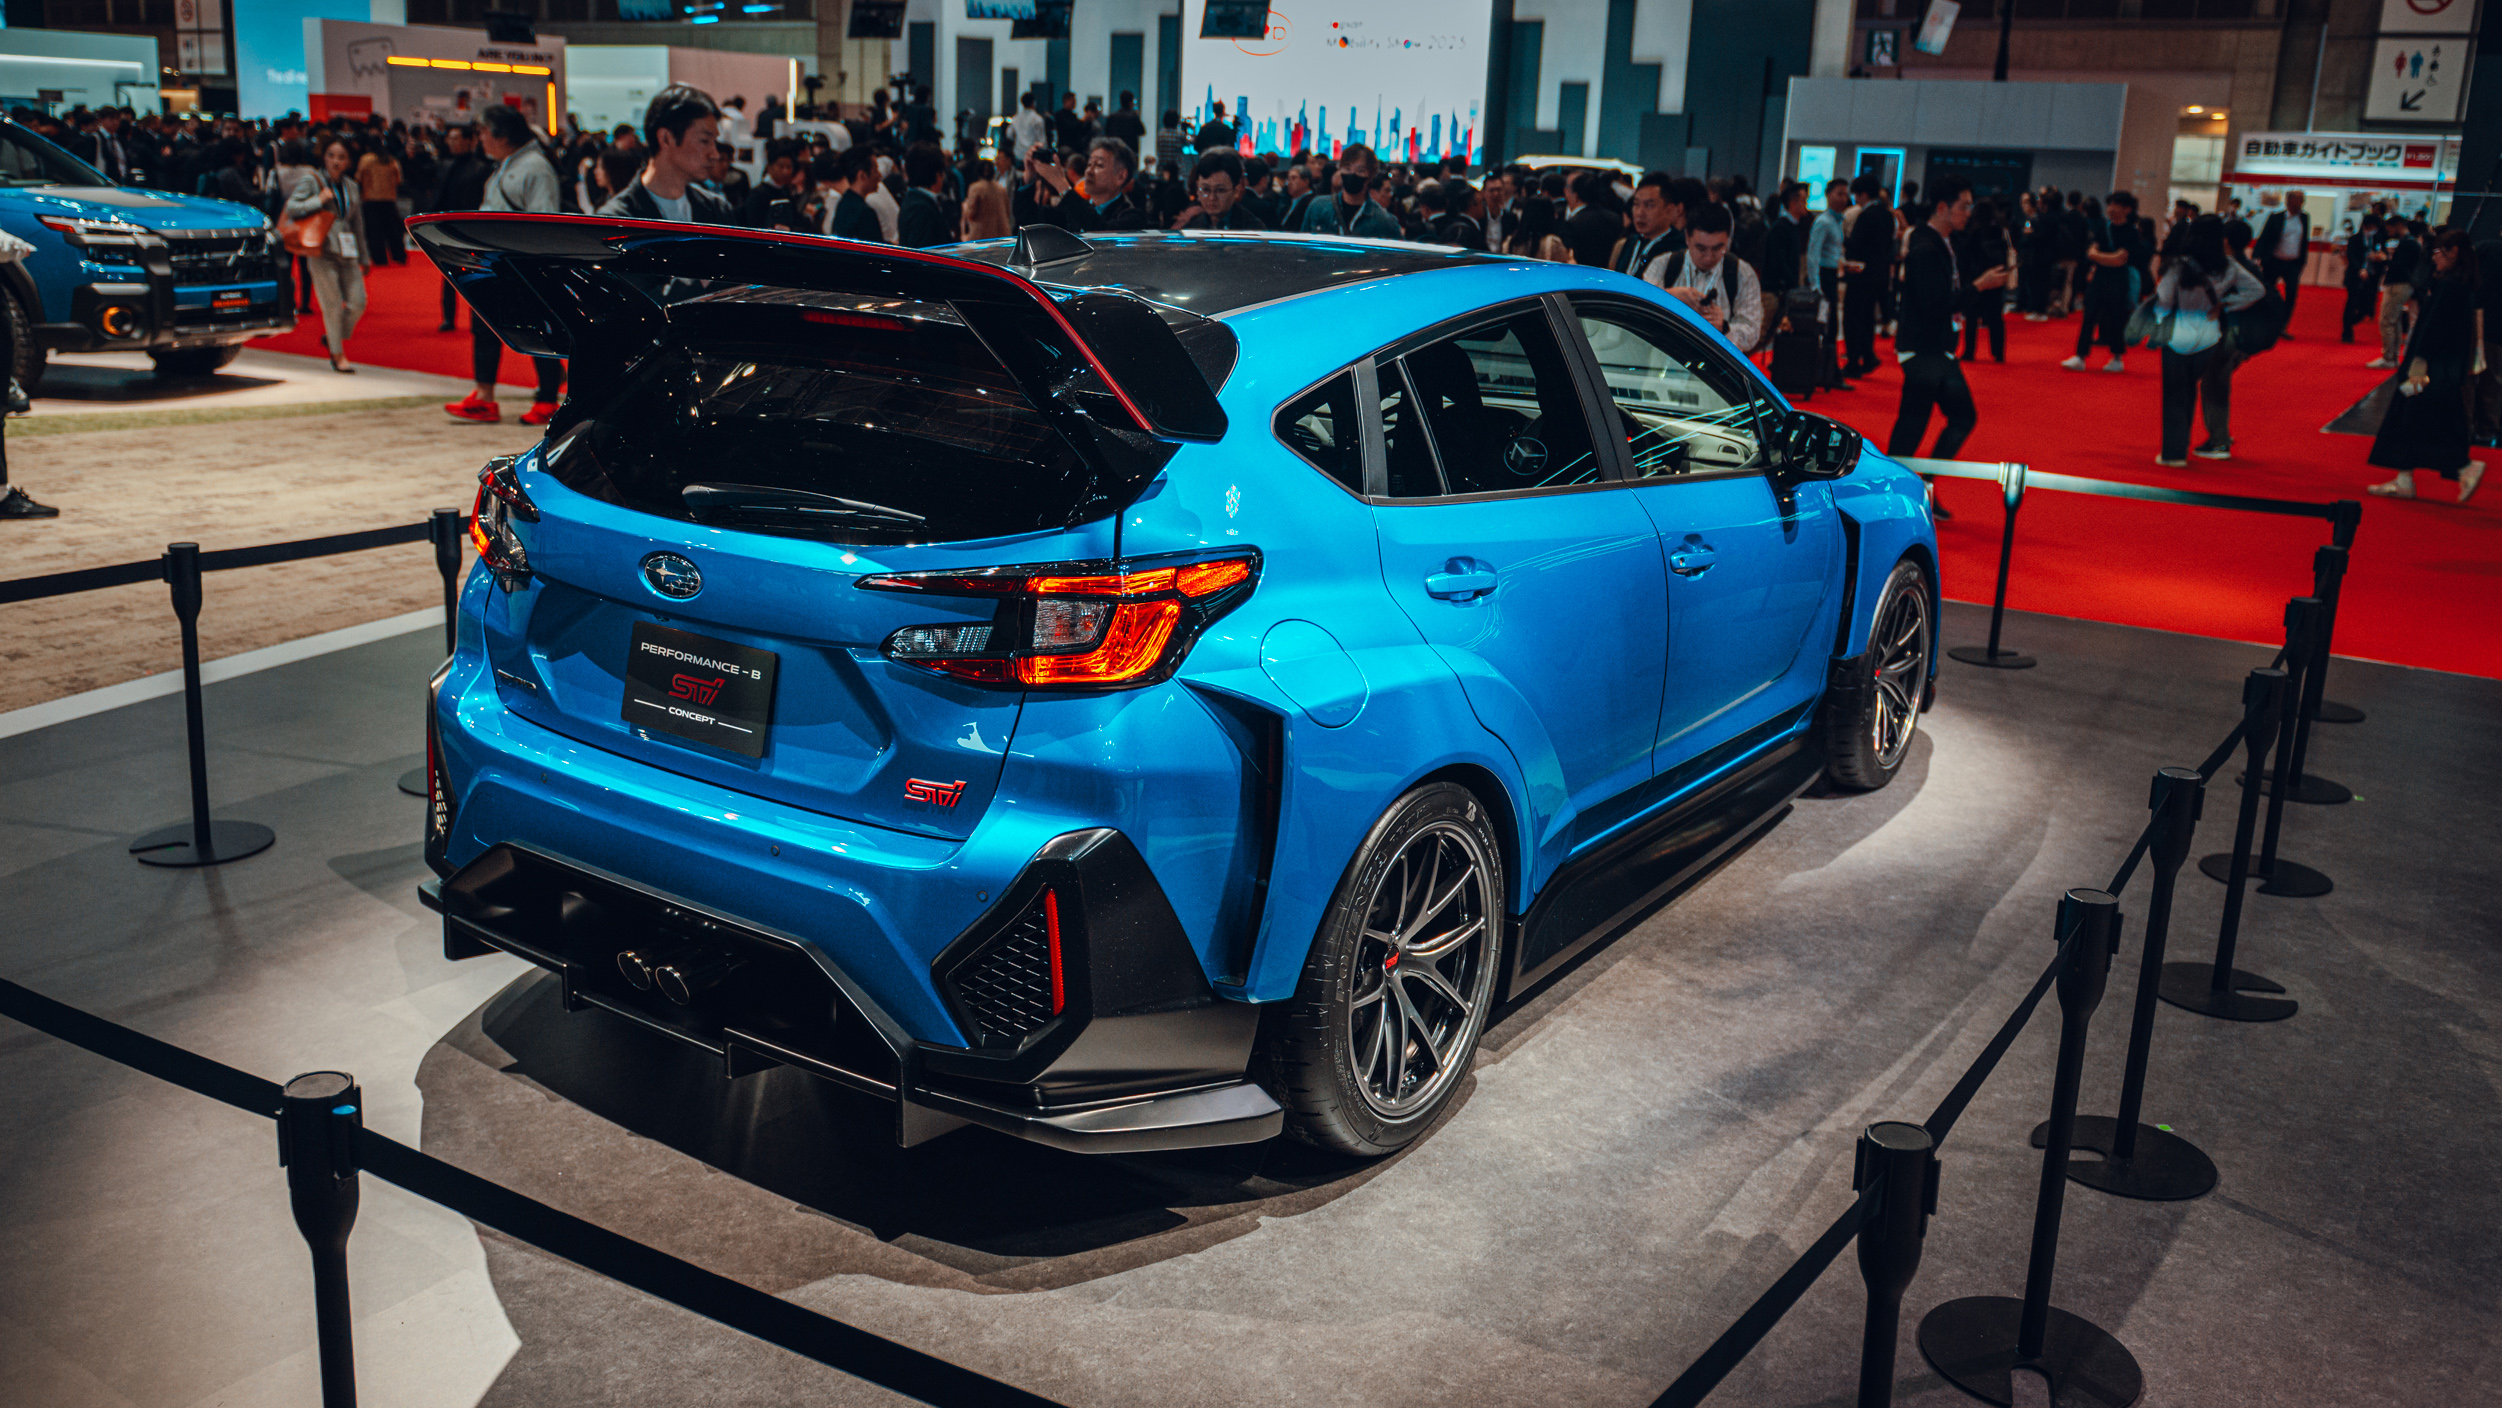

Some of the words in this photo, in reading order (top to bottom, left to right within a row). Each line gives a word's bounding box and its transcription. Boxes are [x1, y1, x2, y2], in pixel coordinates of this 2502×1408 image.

[1429, 35, 1467, 50] 2025
[2245, 140, 2402, 162] 自動車ガイドブック
[640, 642, 740, 675] PERFORMANCE
[751, 669, 762, 680] B
[668, 706, 716, 725] CONCEPT
